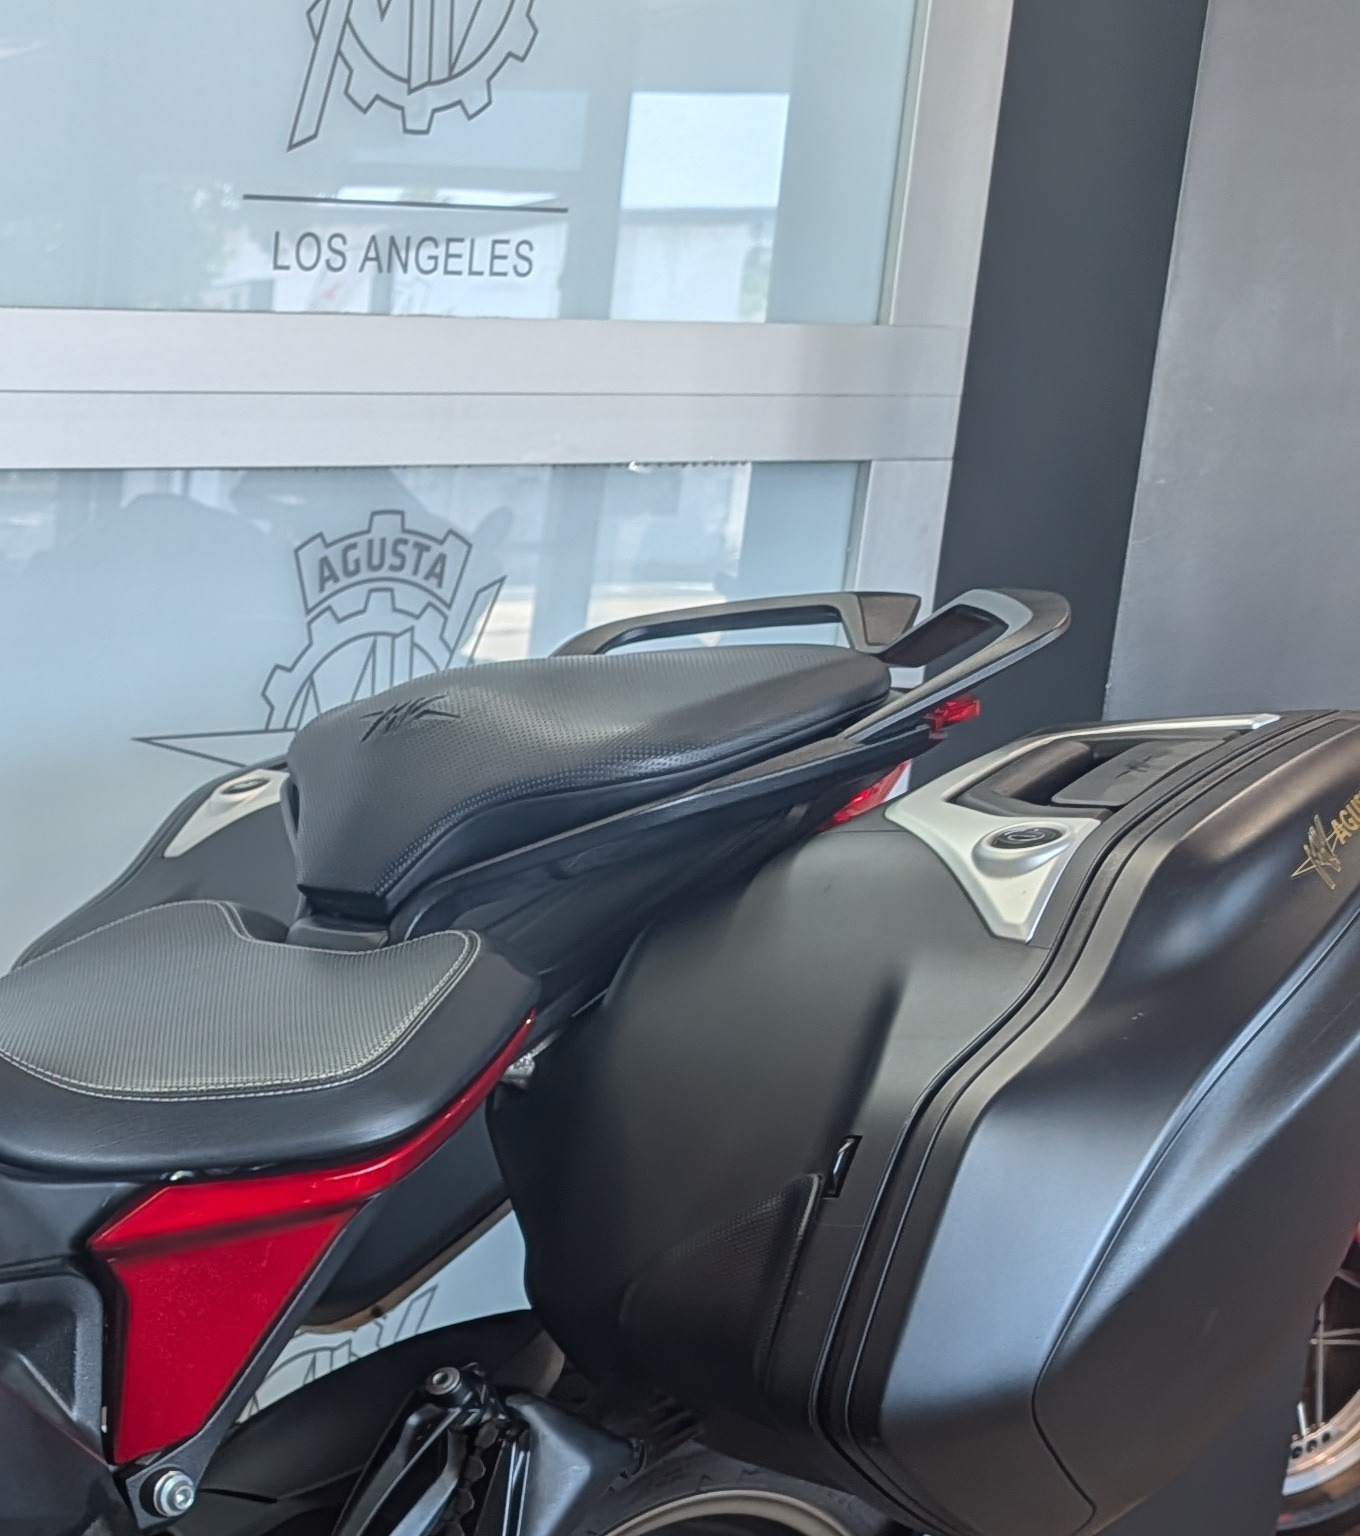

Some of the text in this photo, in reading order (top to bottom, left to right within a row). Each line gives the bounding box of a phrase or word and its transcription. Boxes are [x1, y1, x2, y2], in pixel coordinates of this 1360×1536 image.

[271, 230, 535, 279] LOS ANGELES
[317, 536, 450, 595] AGUSTA
